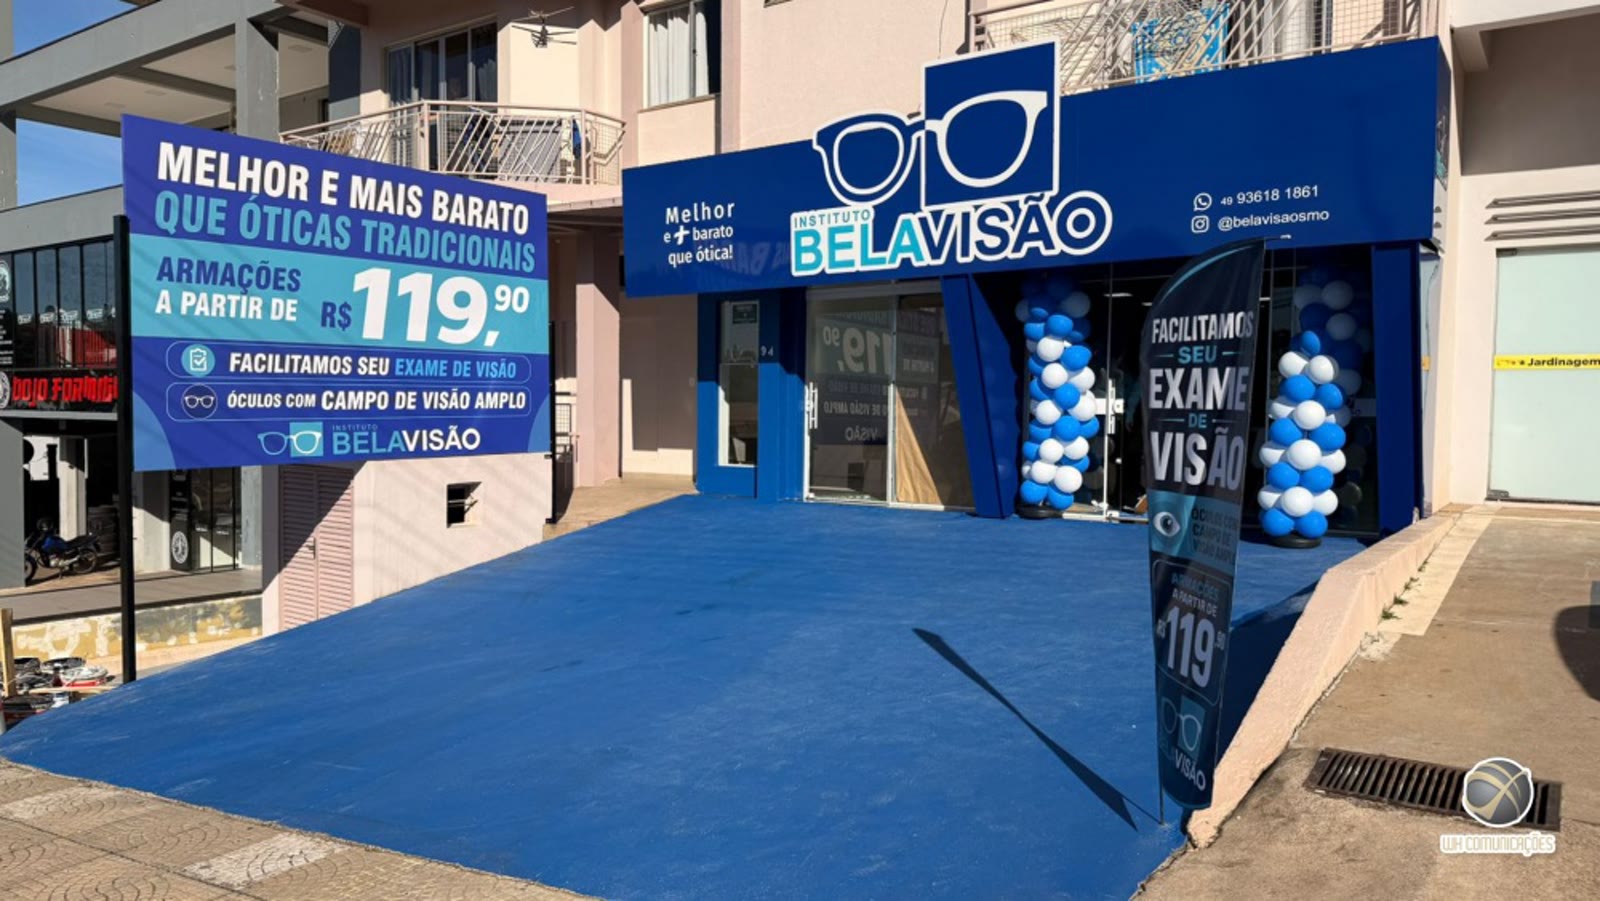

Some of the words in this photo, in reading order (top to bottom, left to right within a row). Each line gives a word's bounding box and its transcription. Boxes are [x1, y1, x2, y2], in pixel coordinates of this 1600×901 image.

[157, 141, 310, 201] MELHOR
[321, 170, 340, 206] E
[349, 175, 423, 219] MAIS
[432, 190, 529, 236] BARATO
[1220, 196, 1233, 206] 49
[1236, 188, 1280, 205] 93618
[1284, 185, 1318, 200] 1861
[665, 201, 735, 225] Melhor
[793, 209, 872, 228] INSTITUTO
[1217, 210, 1330, 232] @belavisaosmo
[155, 189, 228, 236] QUE
[239, 194, 352, 250] ÓTICAS
[362, 219, 536, 273] TRADICIONAIS
[663, 231, 671, 244] e
[692, 224, 734, 241] barato
[668, 251, 693, 268] que
[695, 244, 734, 263] ótica!
[156, 256, 302, 294] ARMAÇÕES
[155, 290, 172, 314] A
[180, 291, 263, 320] PARTIR
[270, 299, 297, 323] DE
[321, 301, 353, 331] R$
[1151, 311, 1254, 344] FACILITAMOS
[229, 352, 352, 375] FACILITAMOS
[357, 356, 390, 376] SEU
[395, 358, 448, 376] EXAME
[452, 360, 471, 377] DE
[476, 358, 517, 378] VISÃO
[1177, 345, 1218, 365] SEU
[227, 390, 282, 409] ÓCULOS
[285, 393, 316, 408] COM
[321, 390, 389, 410] CAMPO
[395, 391, 417, 410] DE
[422, 388, 470, 410] VISÃO
[474, 391, 526, 410] AMPLO
[1149, 366, 1250, 411] EXAME
[332, 423, 379, 432] INSTITUTO
[1187, 413, 1207, 429] DE
[332, 425, 481, 455] BELAVISÃO
[1150, 426, 1245, 491] VISÃO
